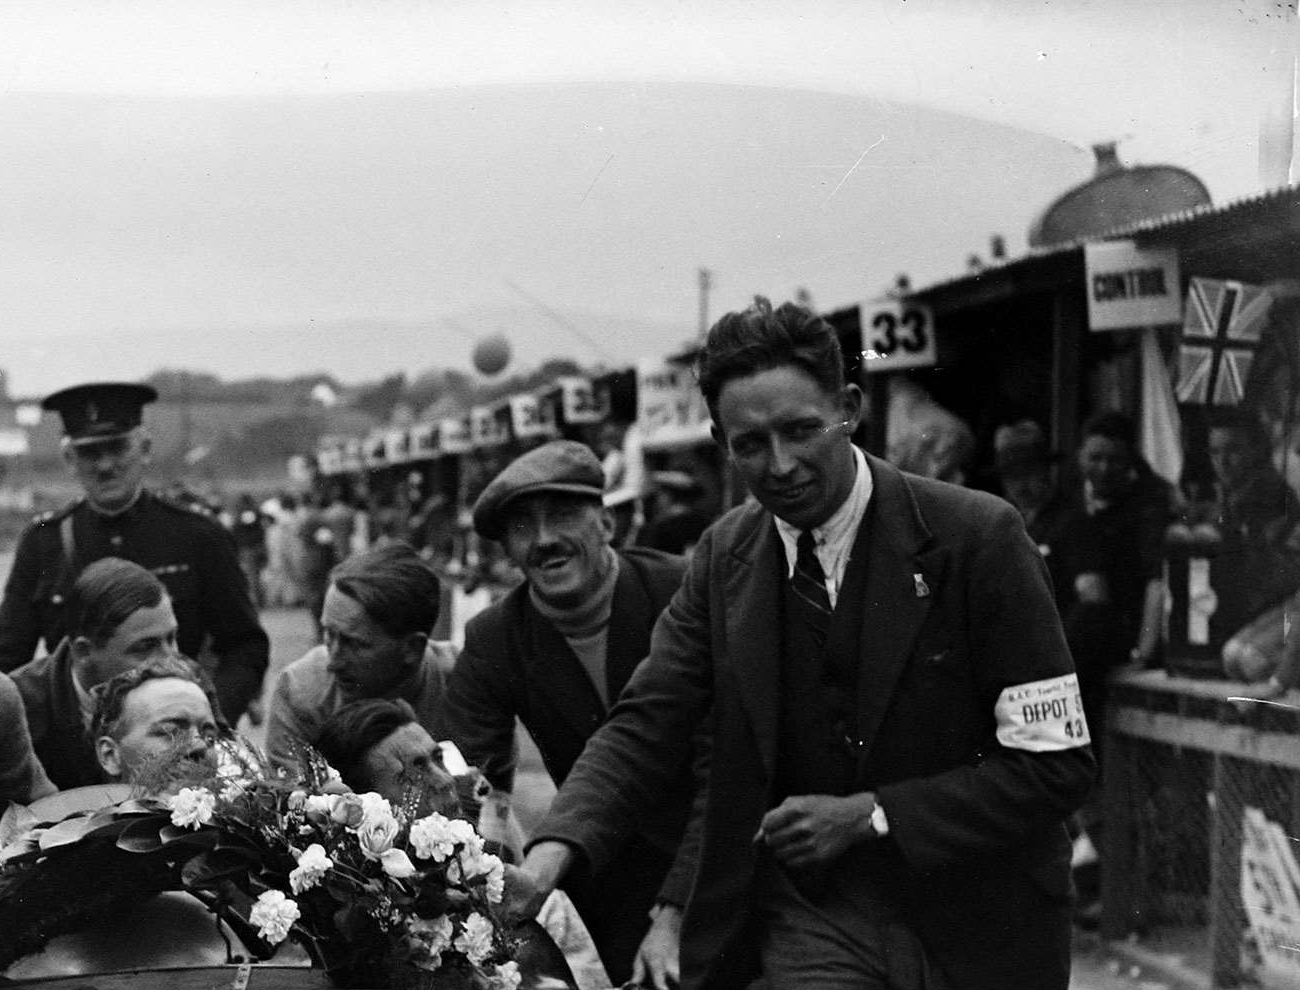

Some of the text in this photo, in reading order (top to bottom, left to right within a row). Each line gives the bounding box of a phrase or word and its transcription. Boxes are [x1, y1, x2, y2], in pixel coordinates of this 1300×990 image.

[873, 310, 926, 355] 33
[1023, 697, 1068, 724] DEPOT
[1064, 718, 1084, 739] 43
